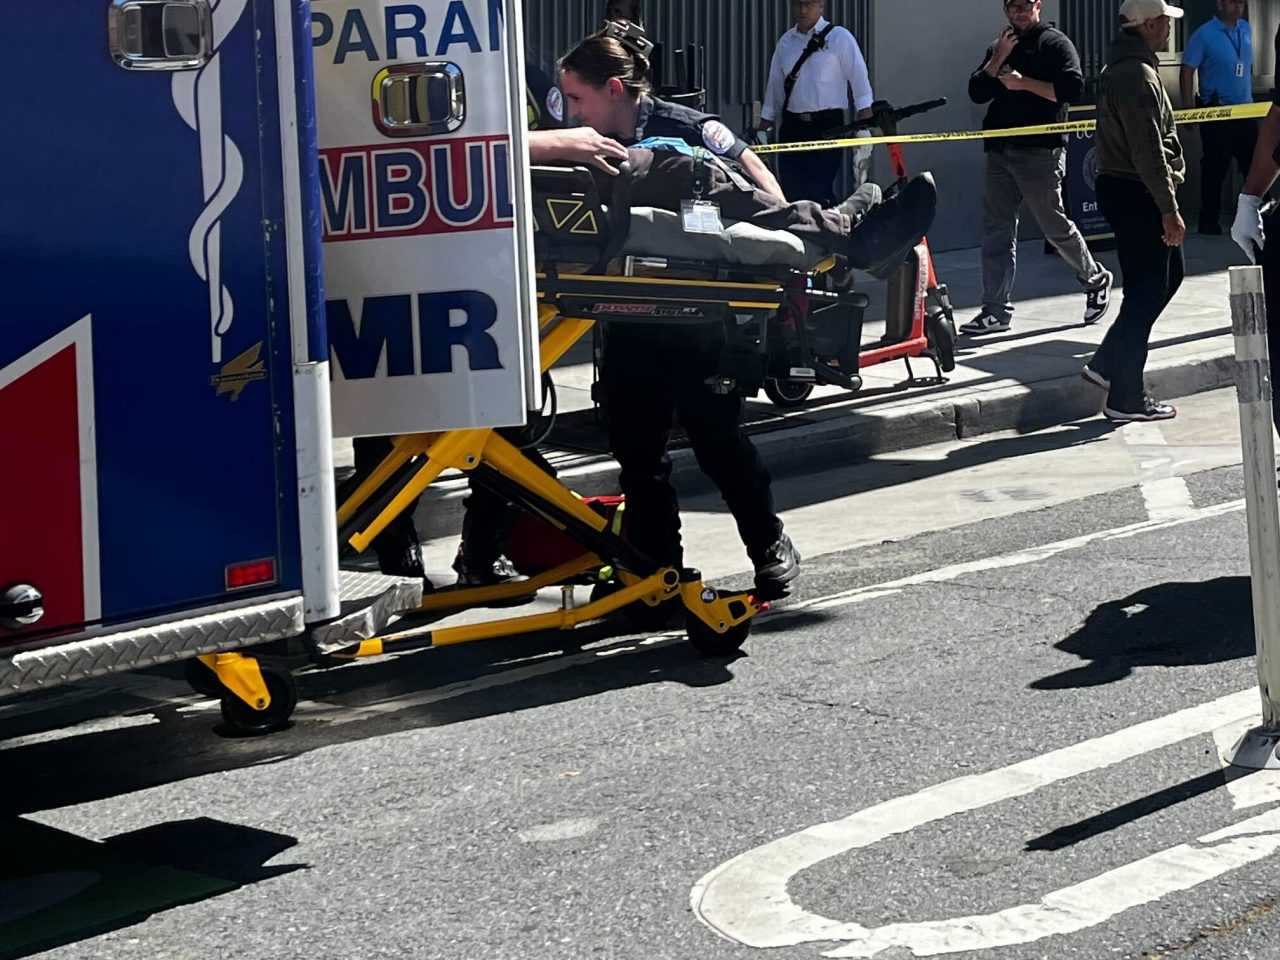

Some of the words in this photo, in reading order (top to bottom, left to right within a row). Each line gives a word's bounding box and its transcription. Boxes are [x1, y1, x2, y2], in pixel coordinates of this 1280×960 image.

[318, 140, 514, 235] MBUL
[1082, 201, 1098, 212] Ent
[325, 290, 506, 382] MR
